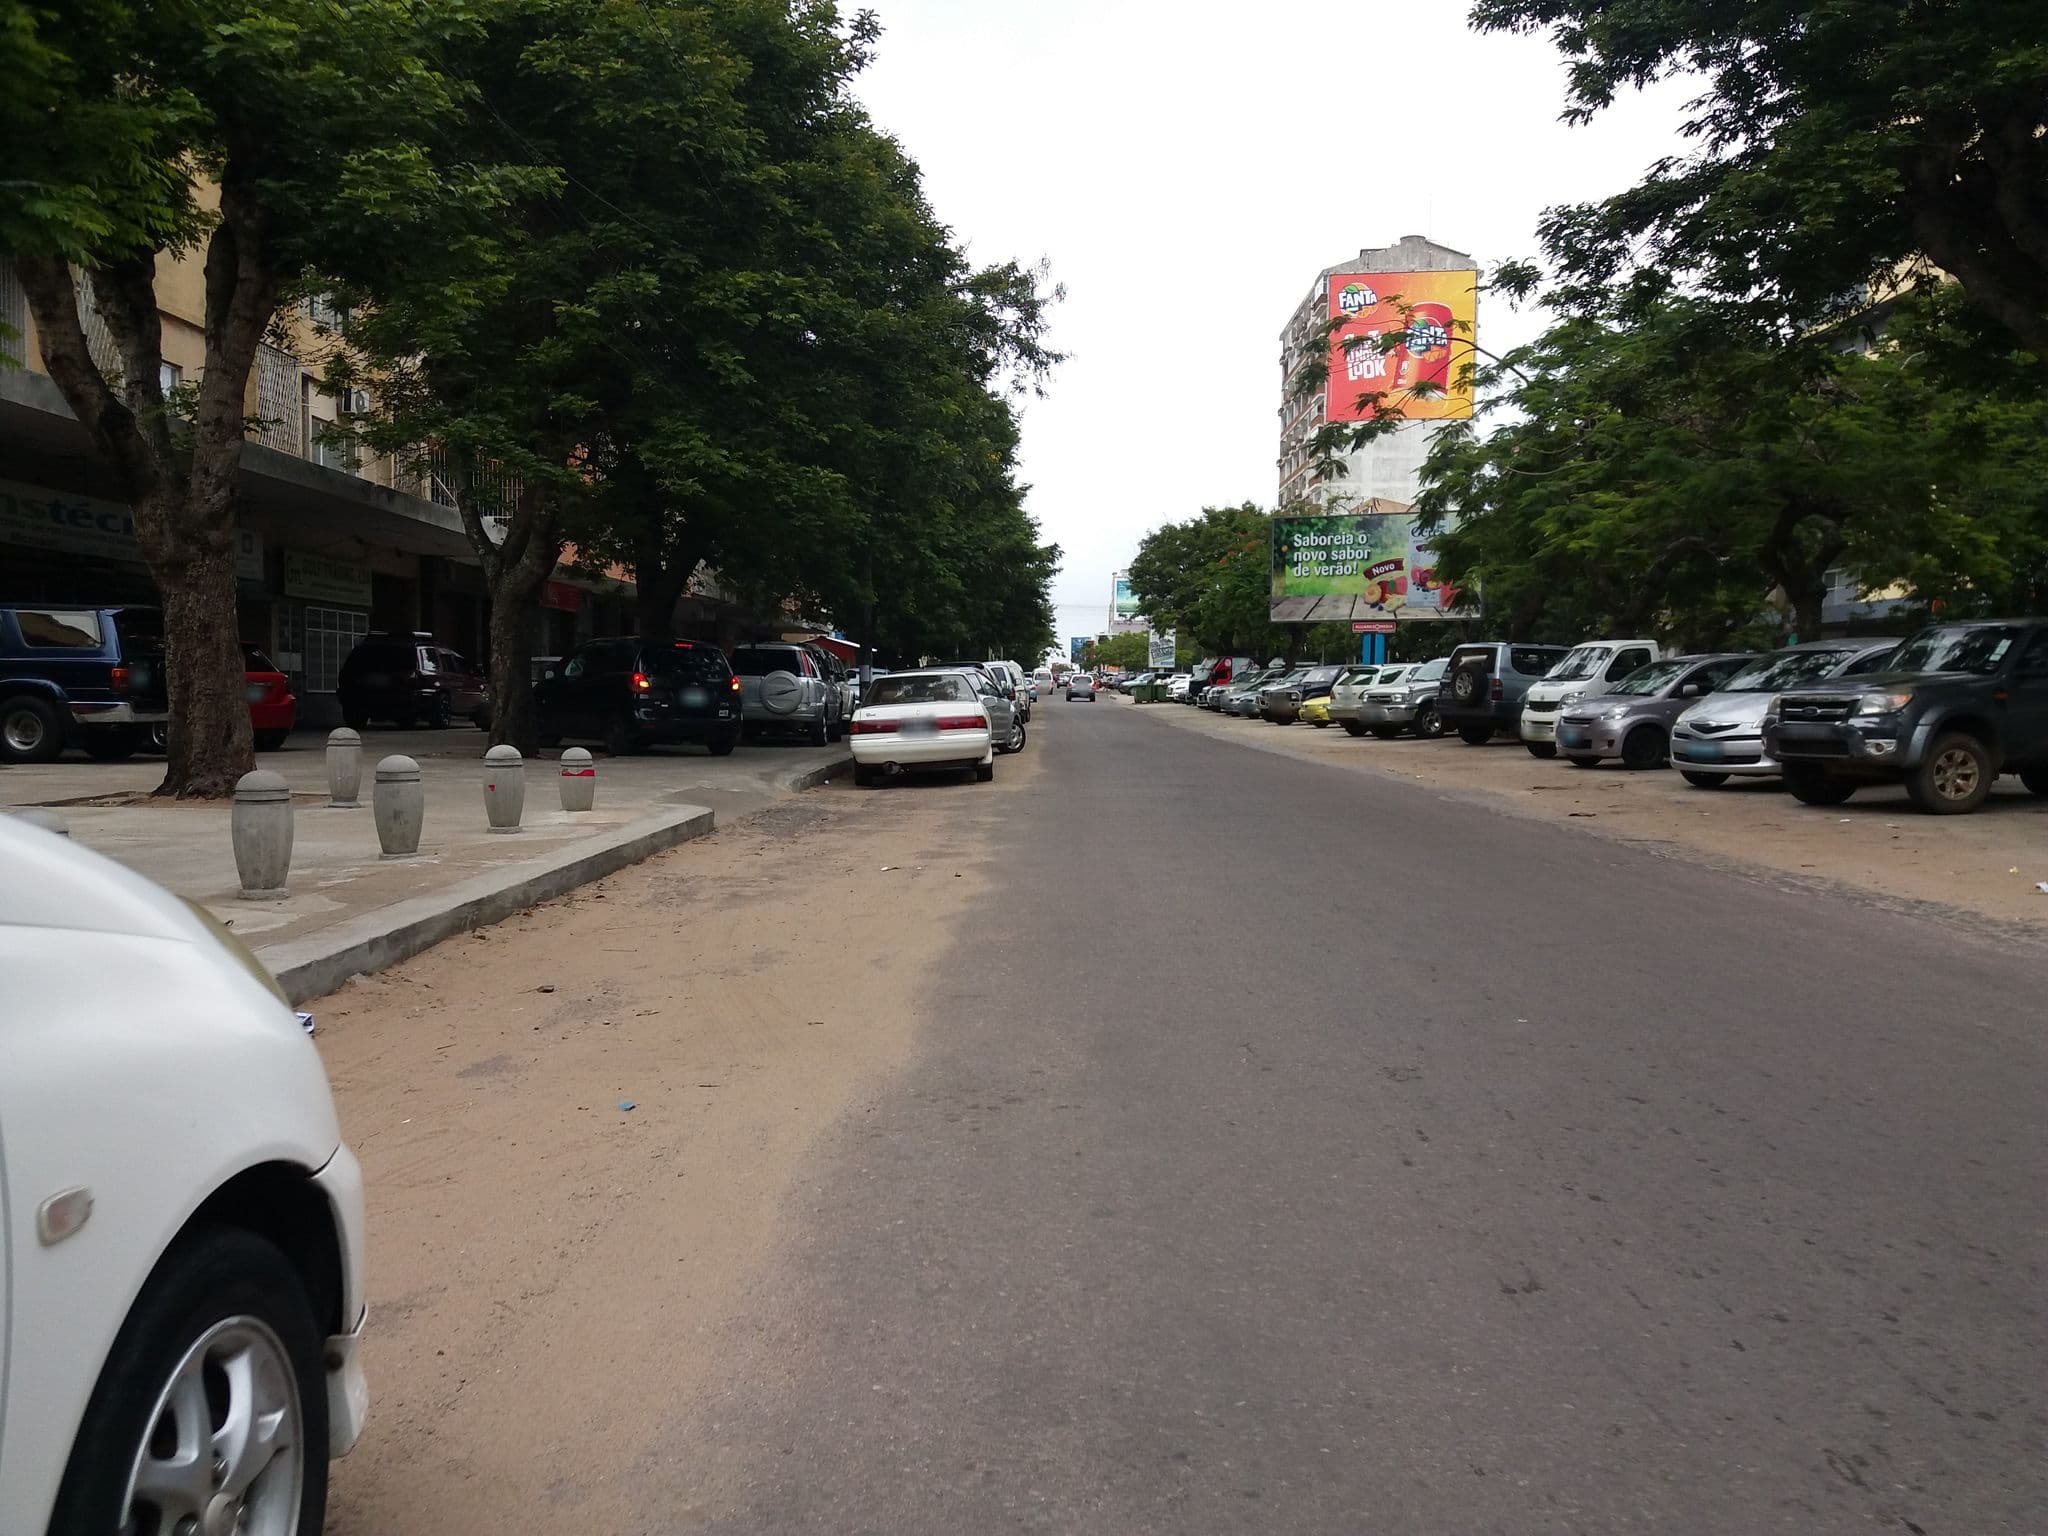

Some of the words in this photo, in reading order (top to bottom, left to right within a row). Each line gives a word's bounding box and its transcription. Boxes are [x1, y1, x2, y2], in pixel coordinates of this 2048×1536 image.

[1338, 290, 1377, 308] FANTA
[1347, 359, 1386, 381] LOOK
[1293, 532, 1353, 547] Saboreia
[1358, 533, 1367, 544] o
[1293, 550, 1327, 561] novo
[1331, 546, 1370, 560] sabor
[1293, 563, 1310, 577] de
[1314, 561, 1357, 576] verão!
[1372, 563, 1395, 576] Novo
